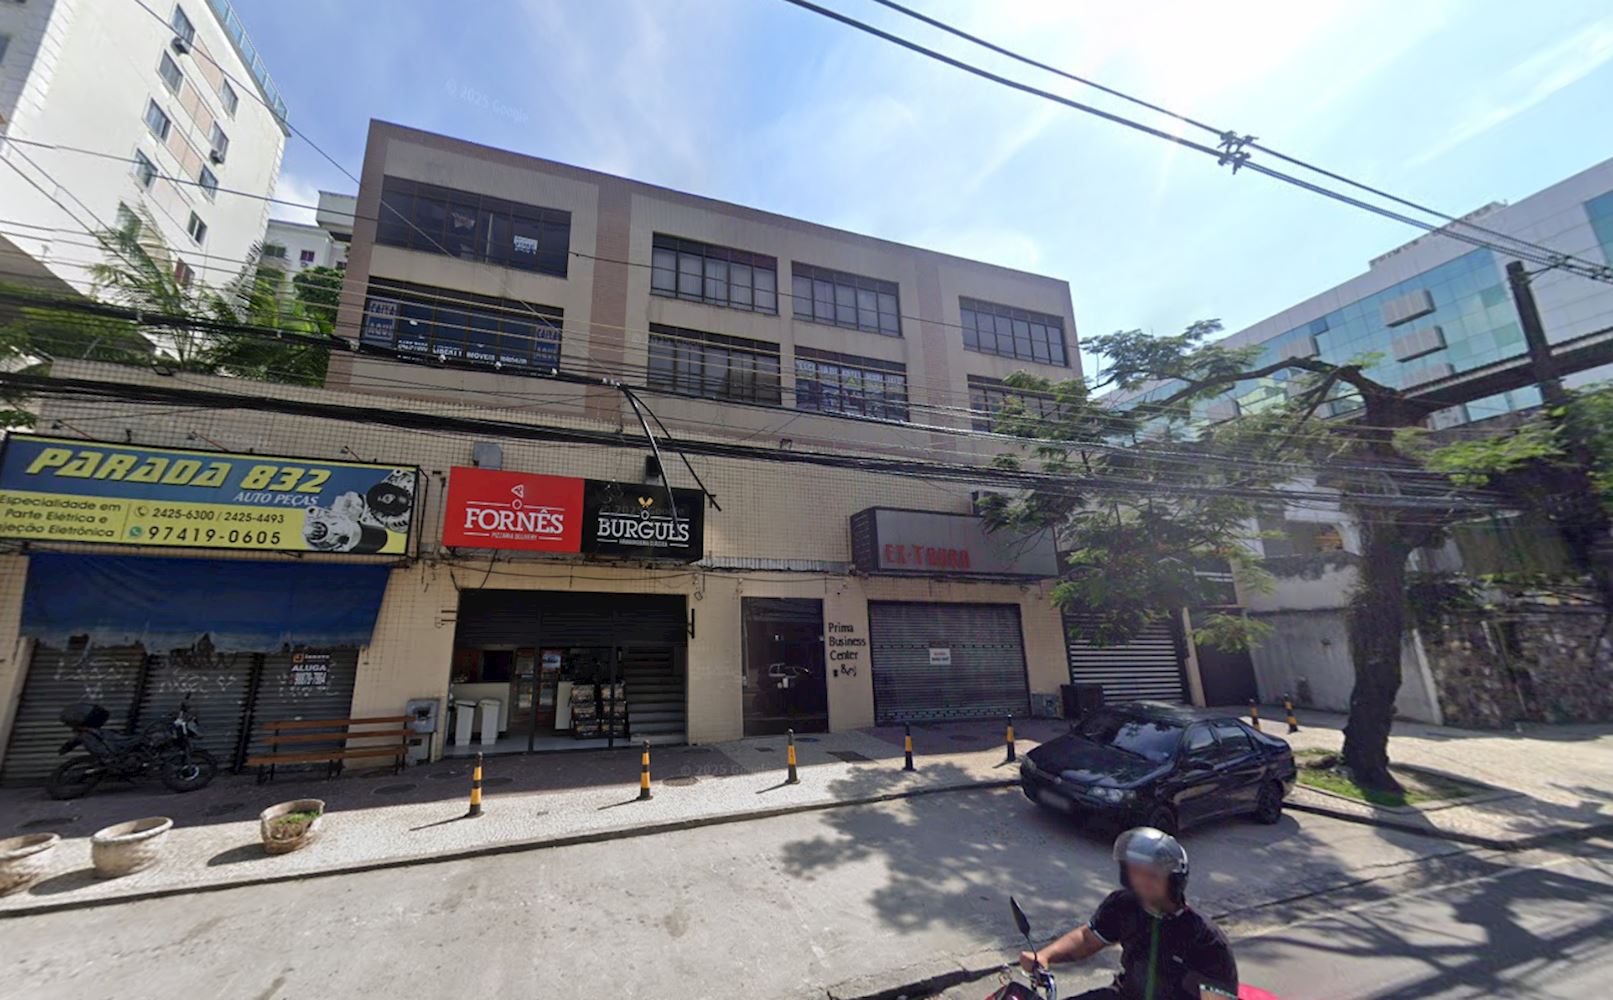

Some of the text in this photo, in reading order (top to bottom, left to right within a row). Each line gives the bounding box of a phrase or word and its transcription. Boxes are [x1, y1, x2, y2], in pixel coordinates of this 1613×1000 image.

[25, 448, 332, 494] PARADA 832
[233, 491, 319, 506] AUTO PEÇAS
[99, 502, 122, 512] em
[5, 508, 108, 524] Parte Elétrica e
[152, 507, 215, 521] 2425-6300
[224, 512, 285, 524] 2425-4493
[464, 507, 565, 535] FORNÊS
[48, 524, 115, 537] Eletrônica
[828, 622, 854, 633] Prima
[829, 636, 867, 647] Business
[829, 650, 859, 661] Center
[291, 664, 327, 672] ALUGA
